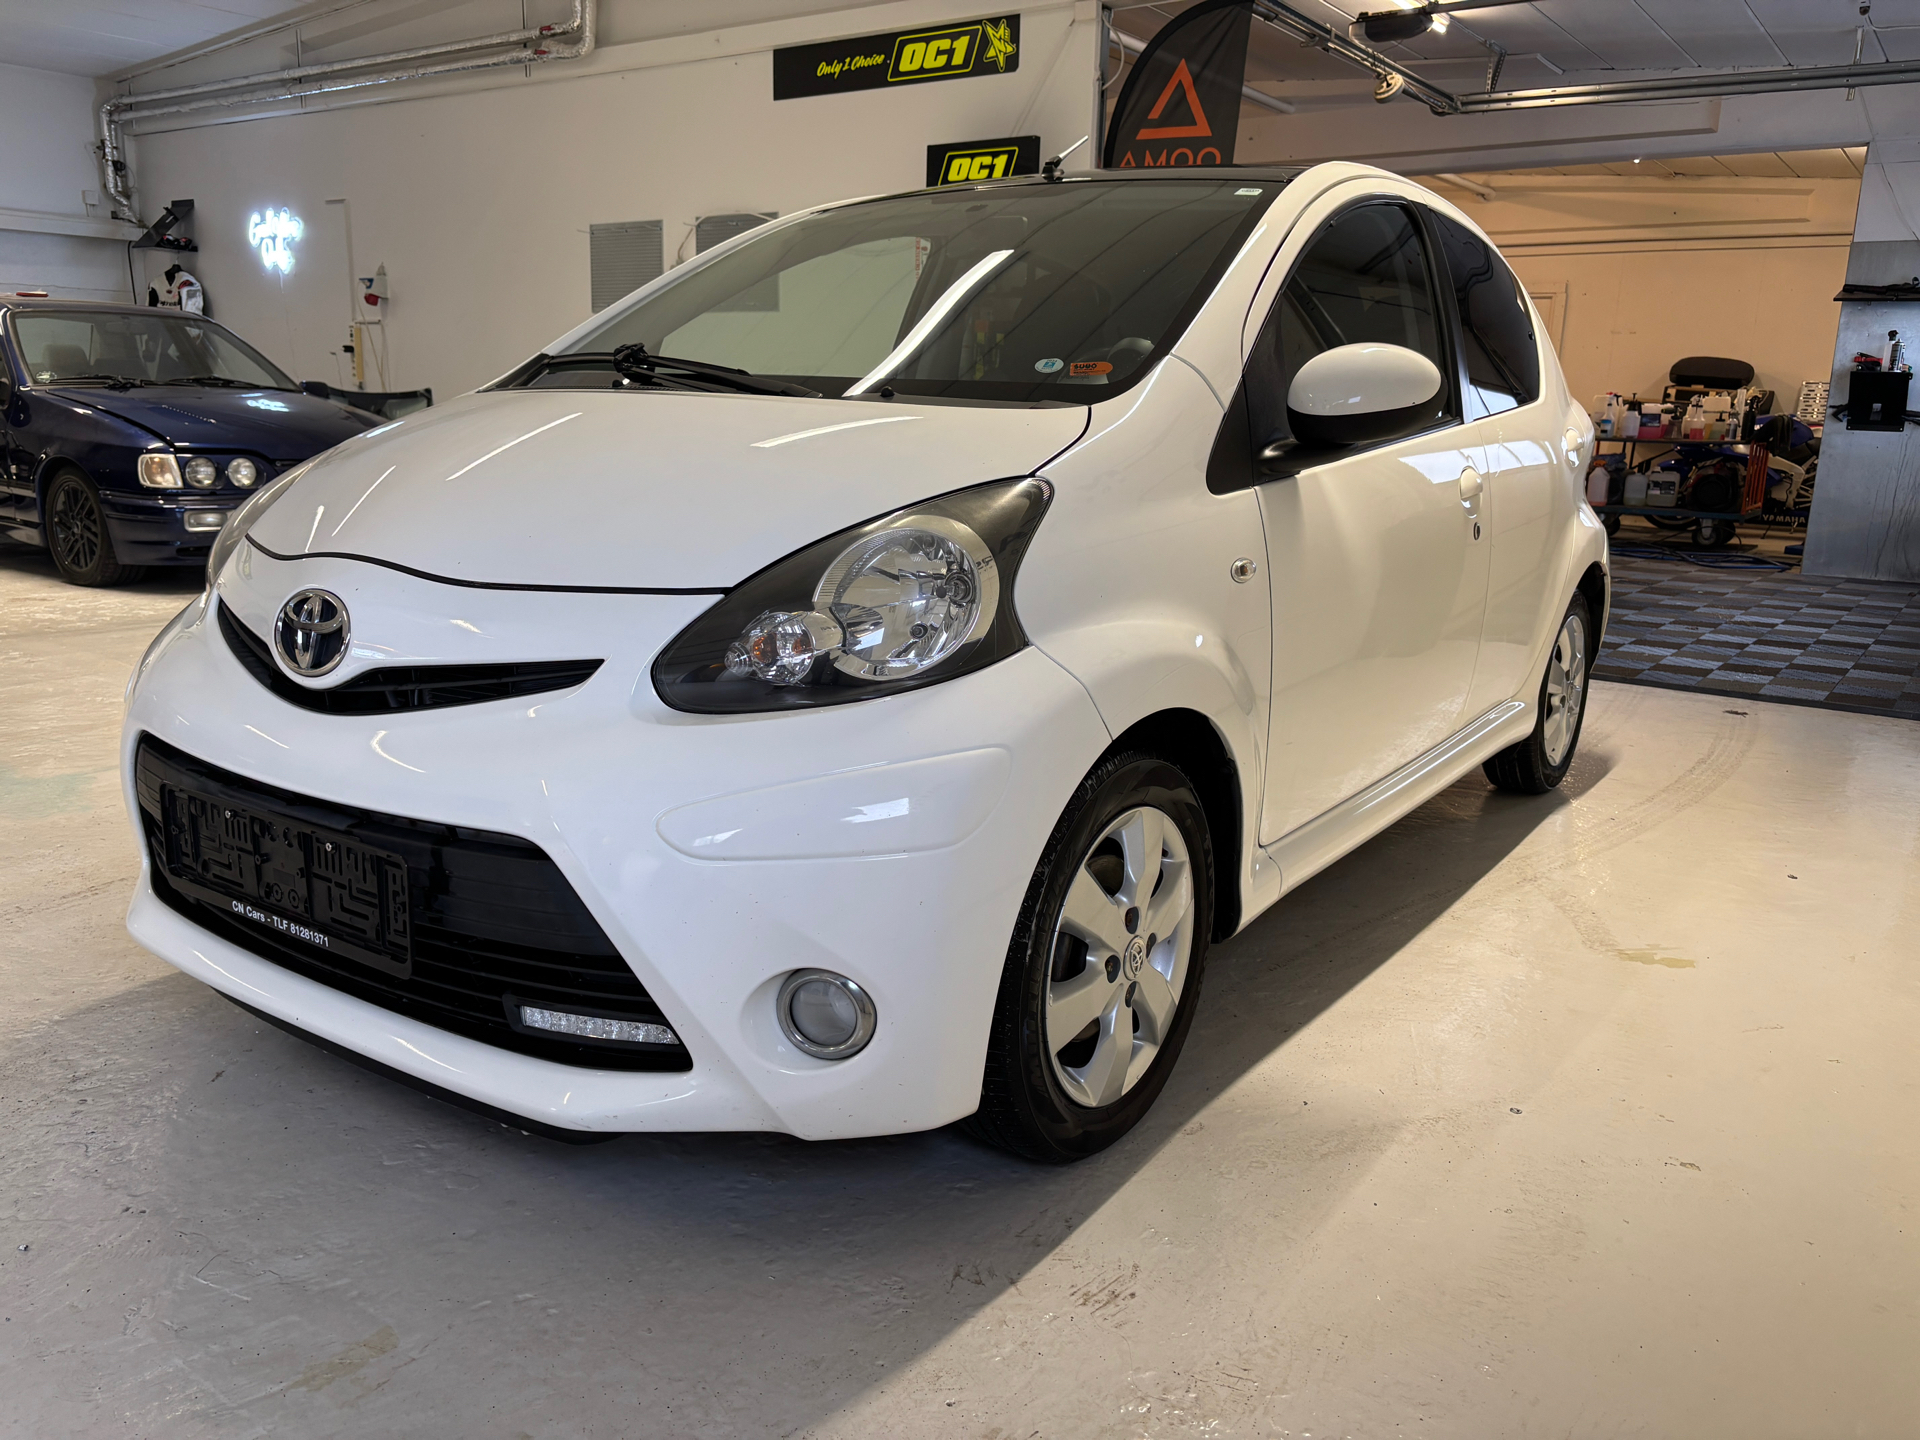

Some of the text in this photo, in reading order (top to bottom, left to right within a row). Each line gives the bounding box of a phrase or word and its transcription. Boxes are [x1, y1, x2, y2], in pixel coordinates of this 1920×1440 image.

[817, 54, 885, 79] Only 1 Choice
[899, 35, 970, 72] OC1
[948, 154, 1008, 181] OC1
[232, 901, 244, 914] CN
[246, 906, 265, 922] Cars
[272, 916, 288, 930] TLF
[290, 923, 329, 947] 81281371
